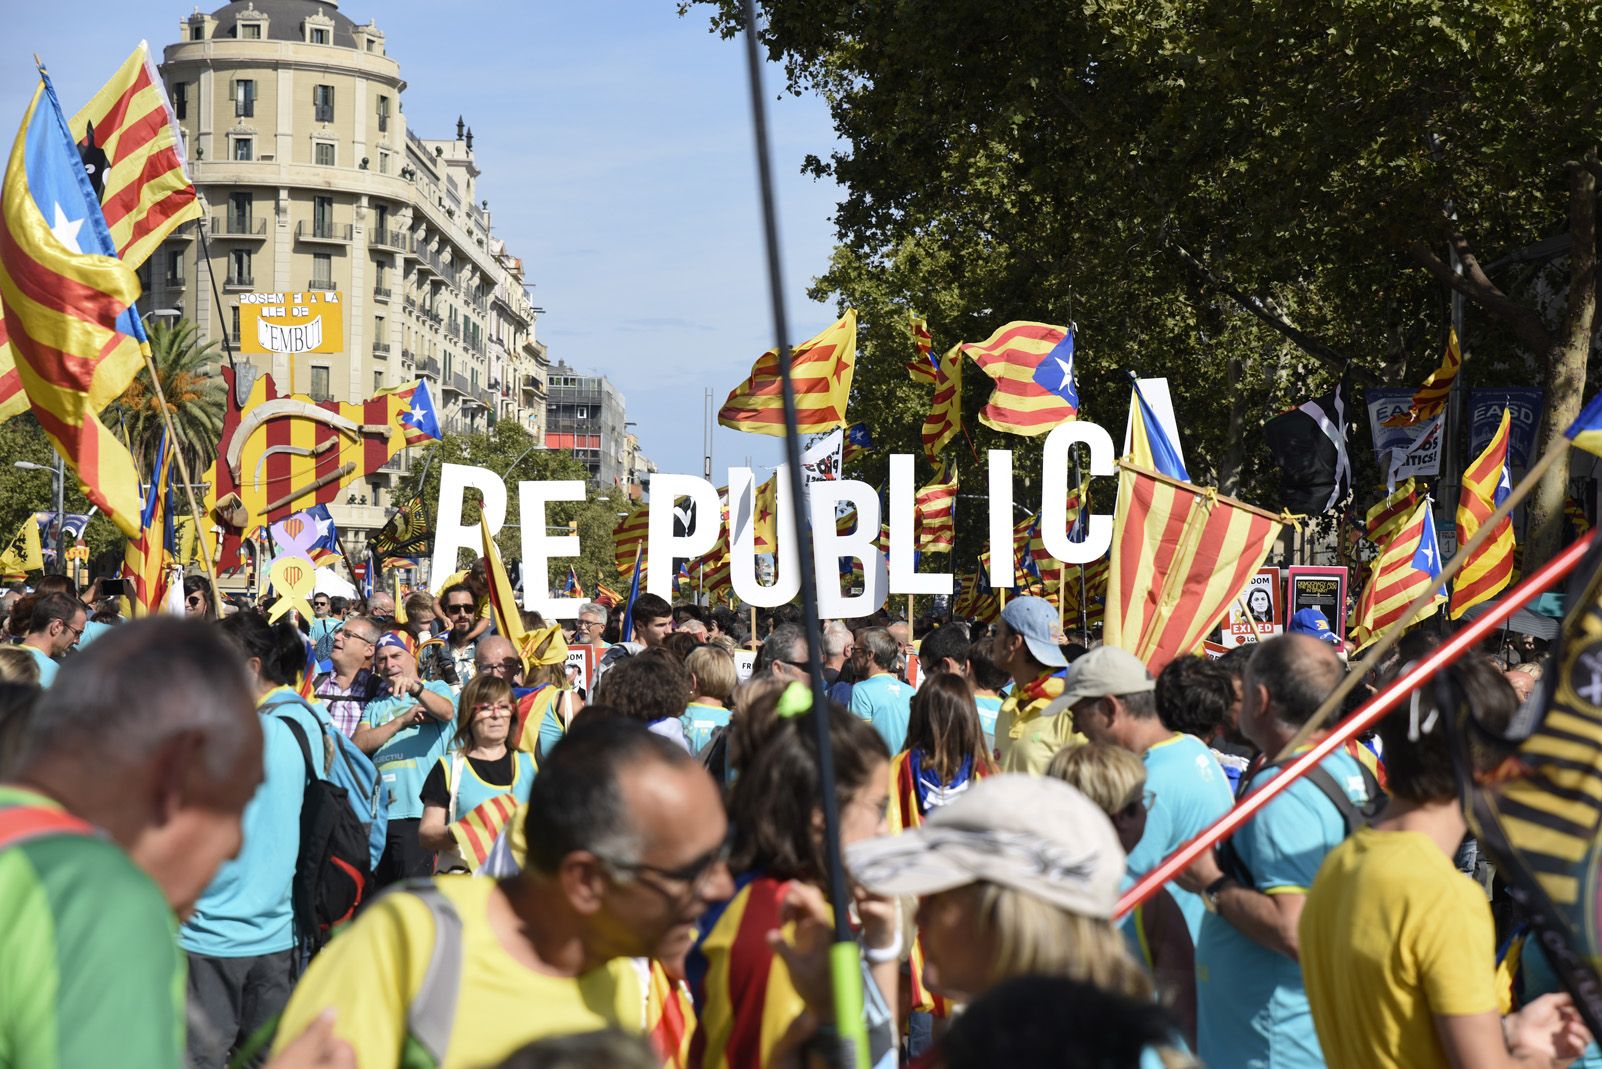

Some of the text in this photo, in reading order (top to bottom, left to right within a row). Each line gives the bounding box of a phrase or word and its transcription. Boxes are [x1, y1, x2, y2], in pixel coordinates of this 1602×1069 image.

[240, 292, 339, 304] POSEM FI A LA
[261, 306, 309, 317] LLEI DE
[1249, 577, 1270, 585] DOM
[1233, 623, 1272, 633] EXIED
